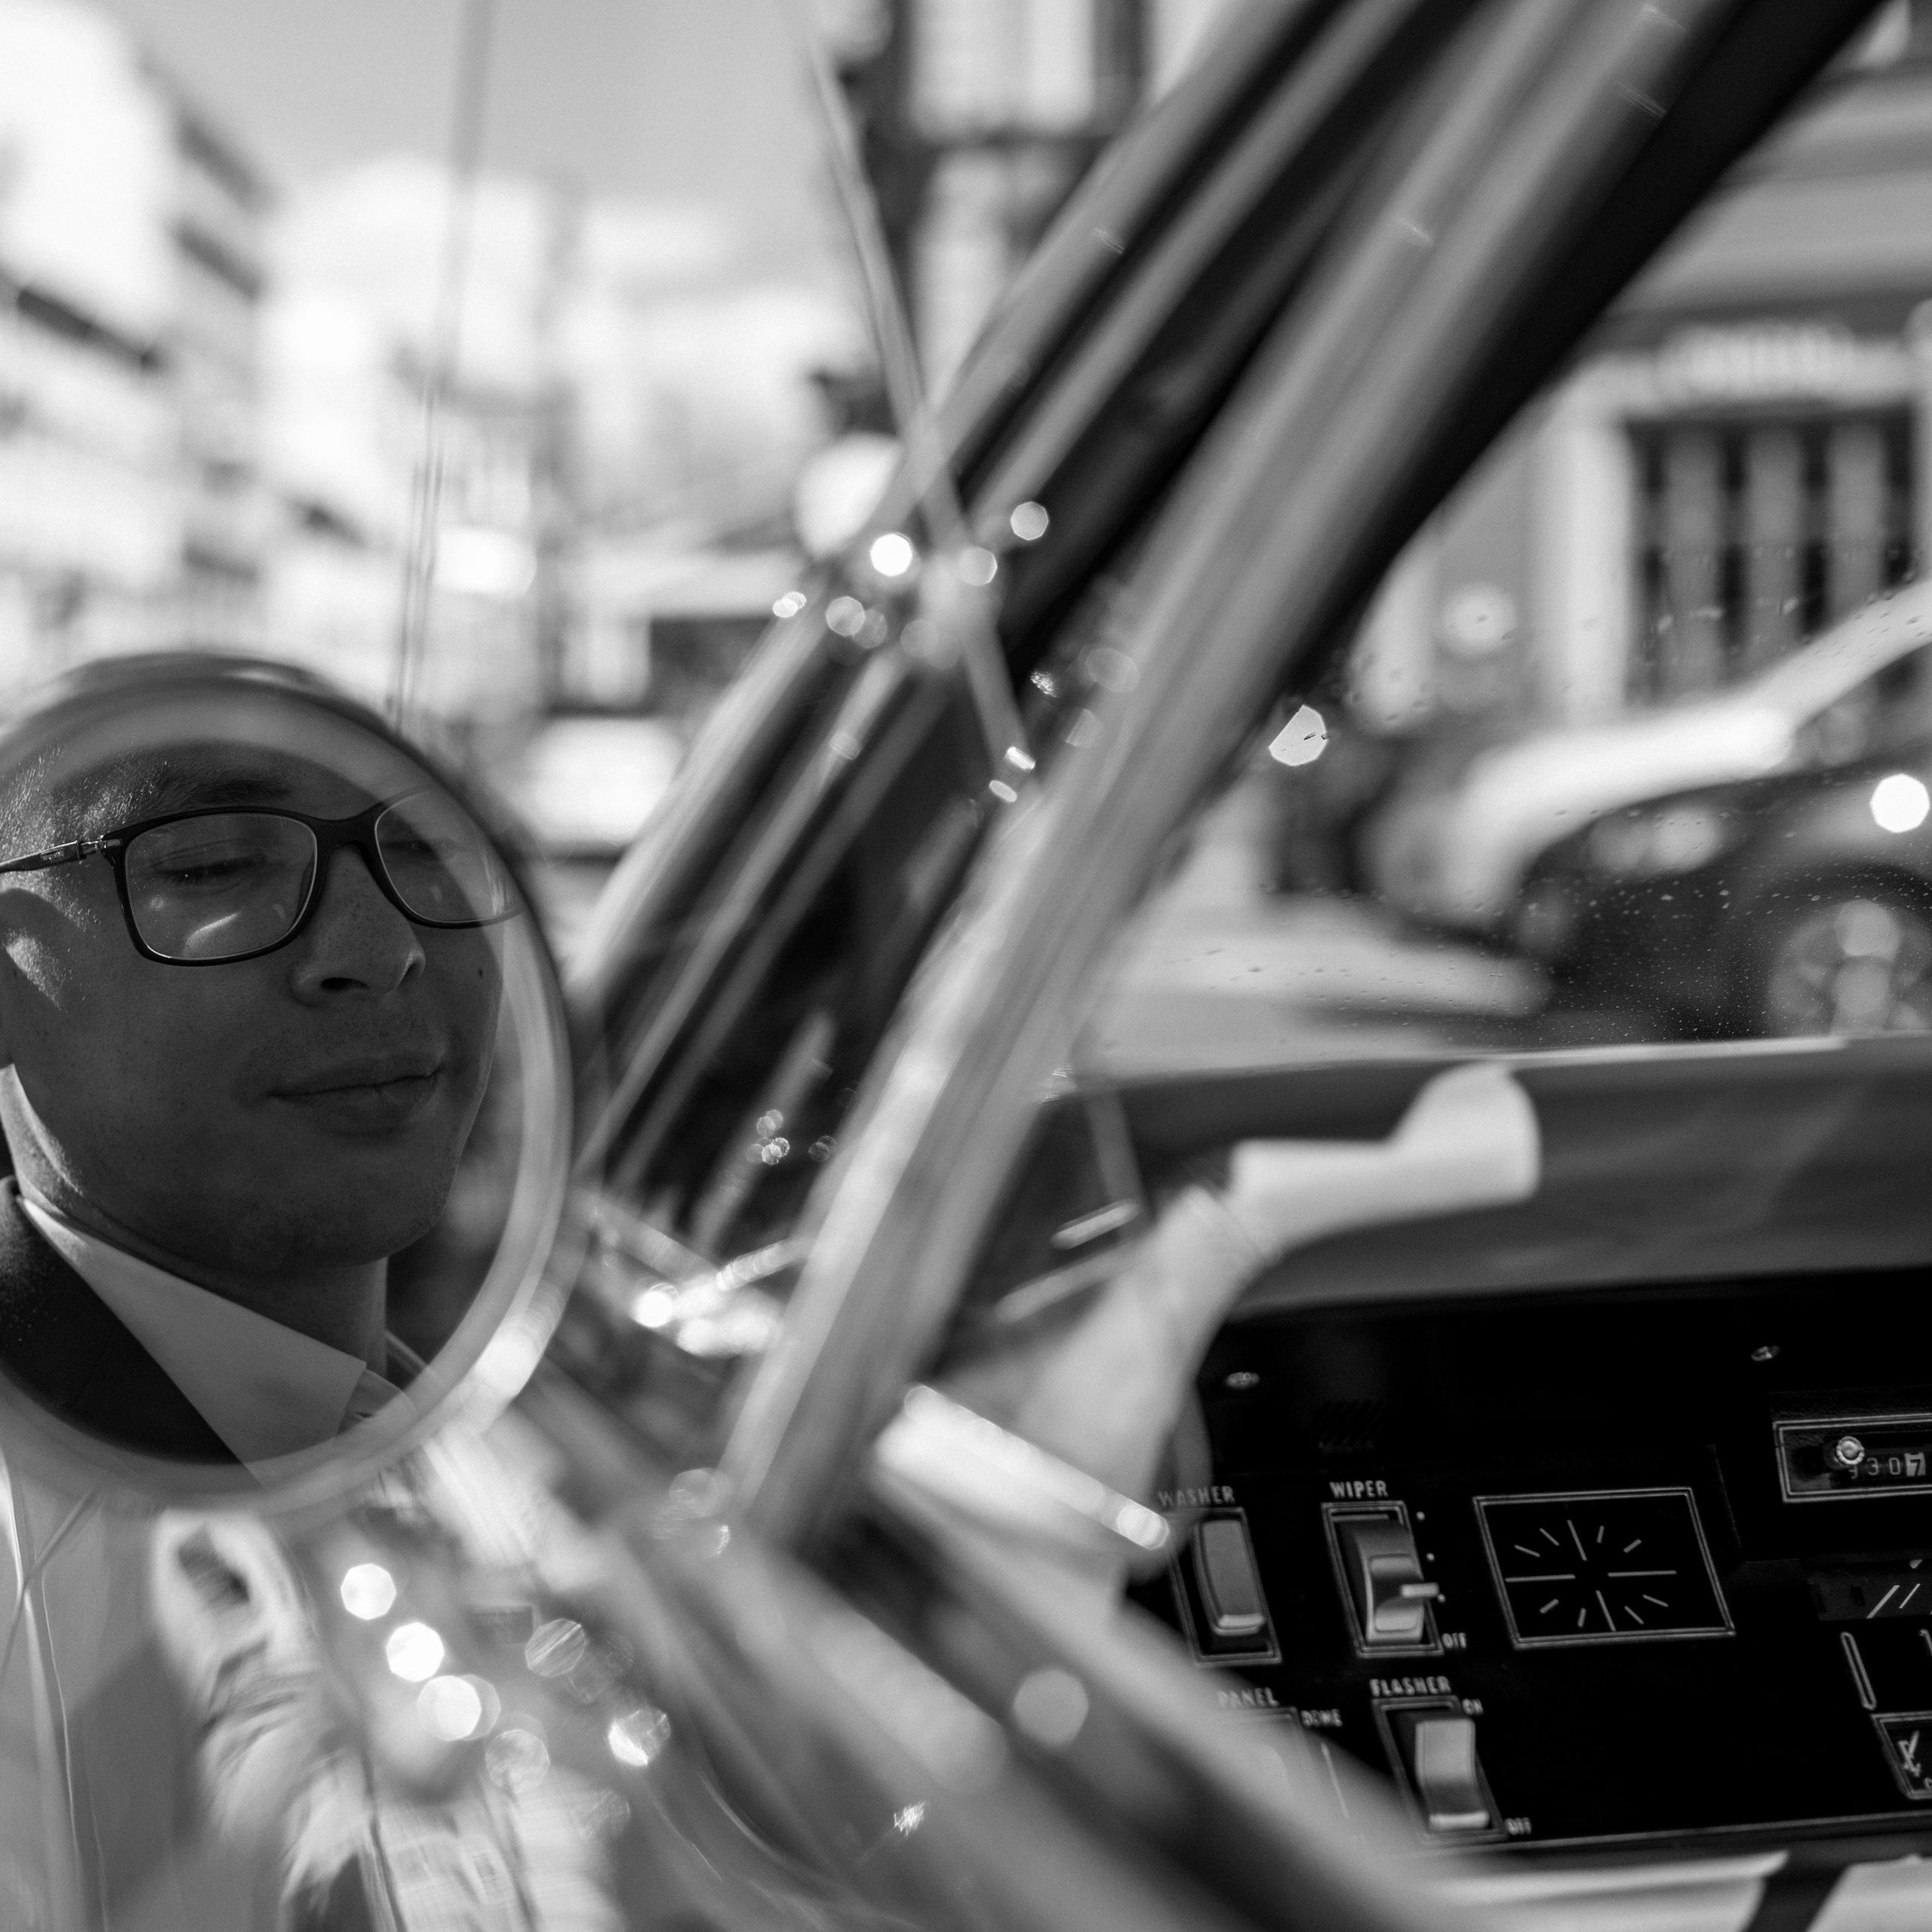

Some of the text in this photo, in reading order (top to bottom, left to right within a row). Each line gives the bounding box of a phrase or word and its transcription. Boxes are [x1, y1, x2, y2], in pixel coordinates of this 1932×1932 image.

[1158, 1485, 1236, 1506] WASHER
[1329, 1480, 1389, 1499] WIPER
[1441, 1632, 1466, 1648] OFF
[1369, 1675, 1451, 1697] FLASHER
[1217, 1687, 1279, 1707] PANEL
[1462, 1698, 1484, 1715] ON
[1300, 1709, 1343, 1727] DOME
[1505, 1817, 1533, 1835] OFF
